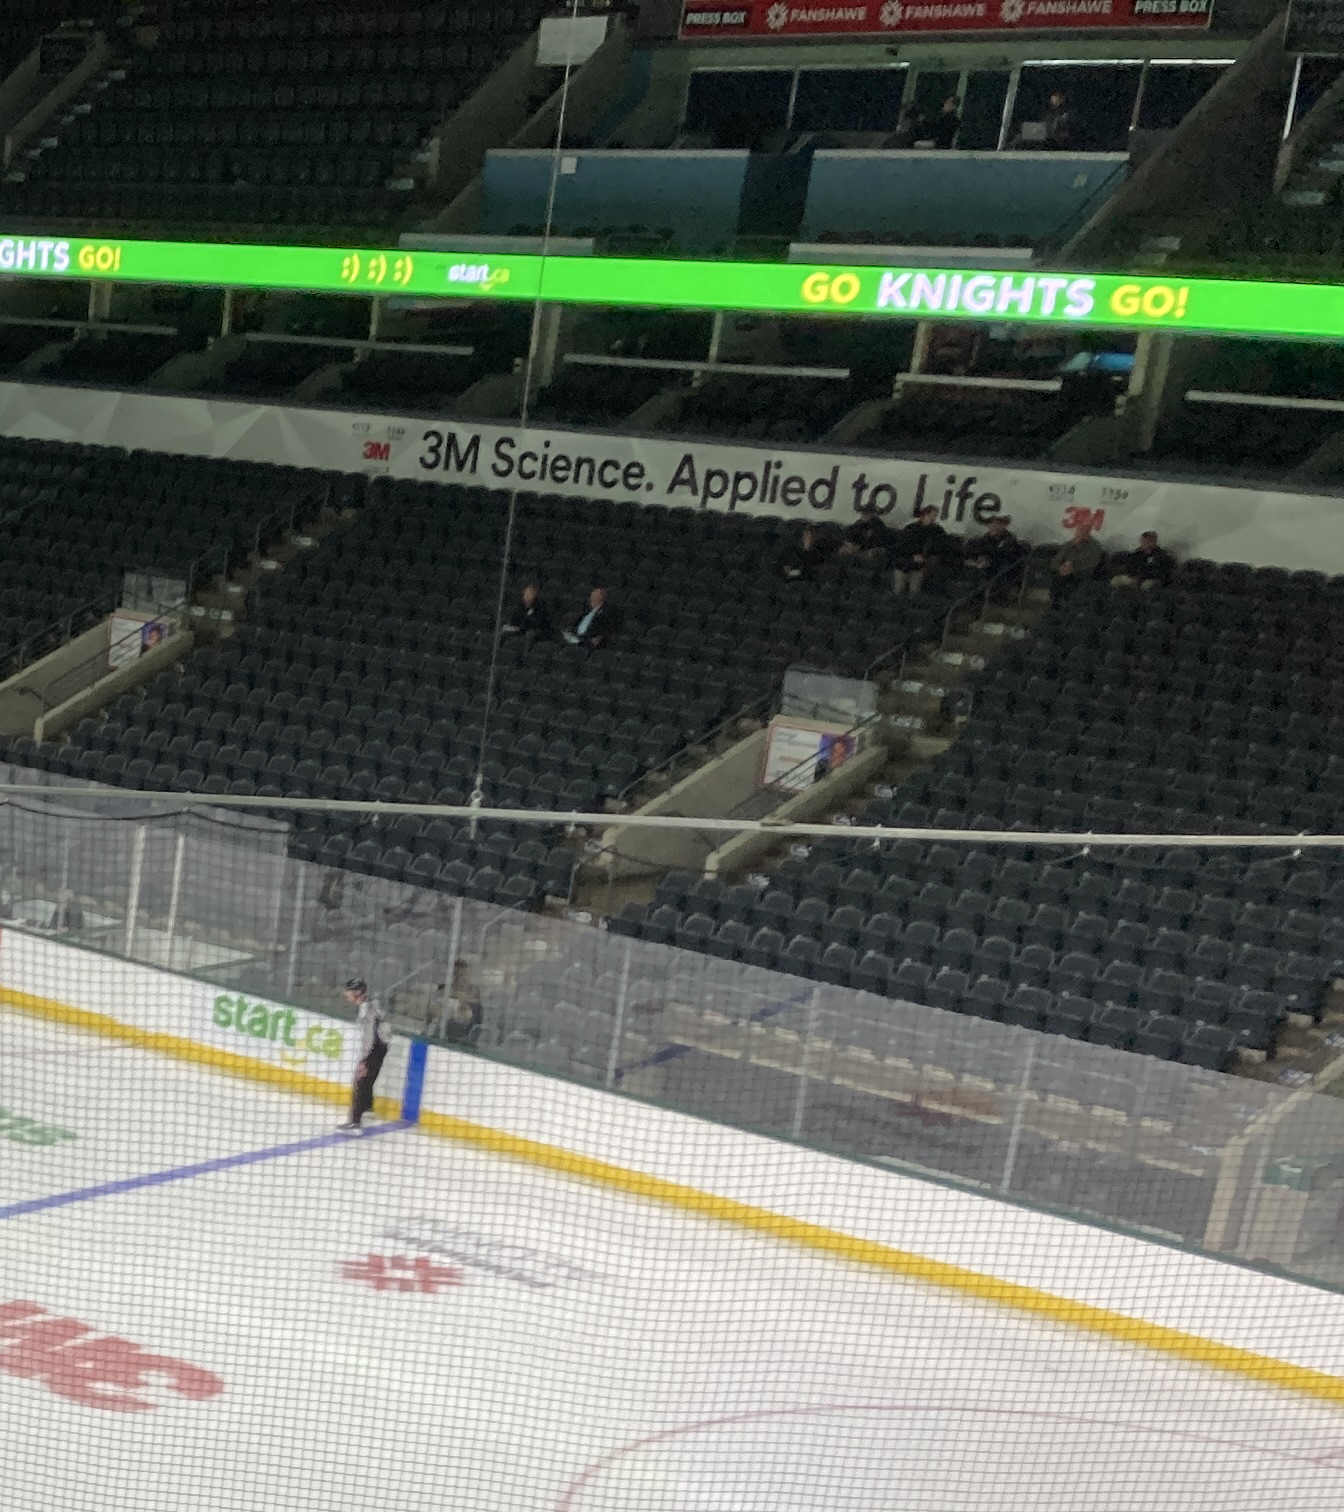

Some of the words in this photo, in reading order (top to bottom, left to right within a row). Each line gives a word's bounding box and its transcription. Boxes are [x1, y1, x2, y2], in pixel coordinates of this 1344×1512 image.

[790, 7, 866, 22] FANSHAWE
[905, 3, 985, 19] FANSHAWE
[1135, 0, 1174, 14] PRESS
[1176, 0, 1209, 13] BOX
[686, 11, 720, 25] PRESS
[722, 11, 746, 24] BOX
[78, 244, 121, 272] GO!
[802, 271, 860, 304] GO
[875, 271, 1095, 318] KNIGHTS
[1110, 279, 1187, 319] GO!
[363, 440, 391, 461] 3M
[419, 430, 481, 474] 3M
[491, 436, 653, 492] Science.
[667, 453, 839, 513] Applied
[852, 473, 897, 514] to
[213, 995, 343, 1058] start.ca
